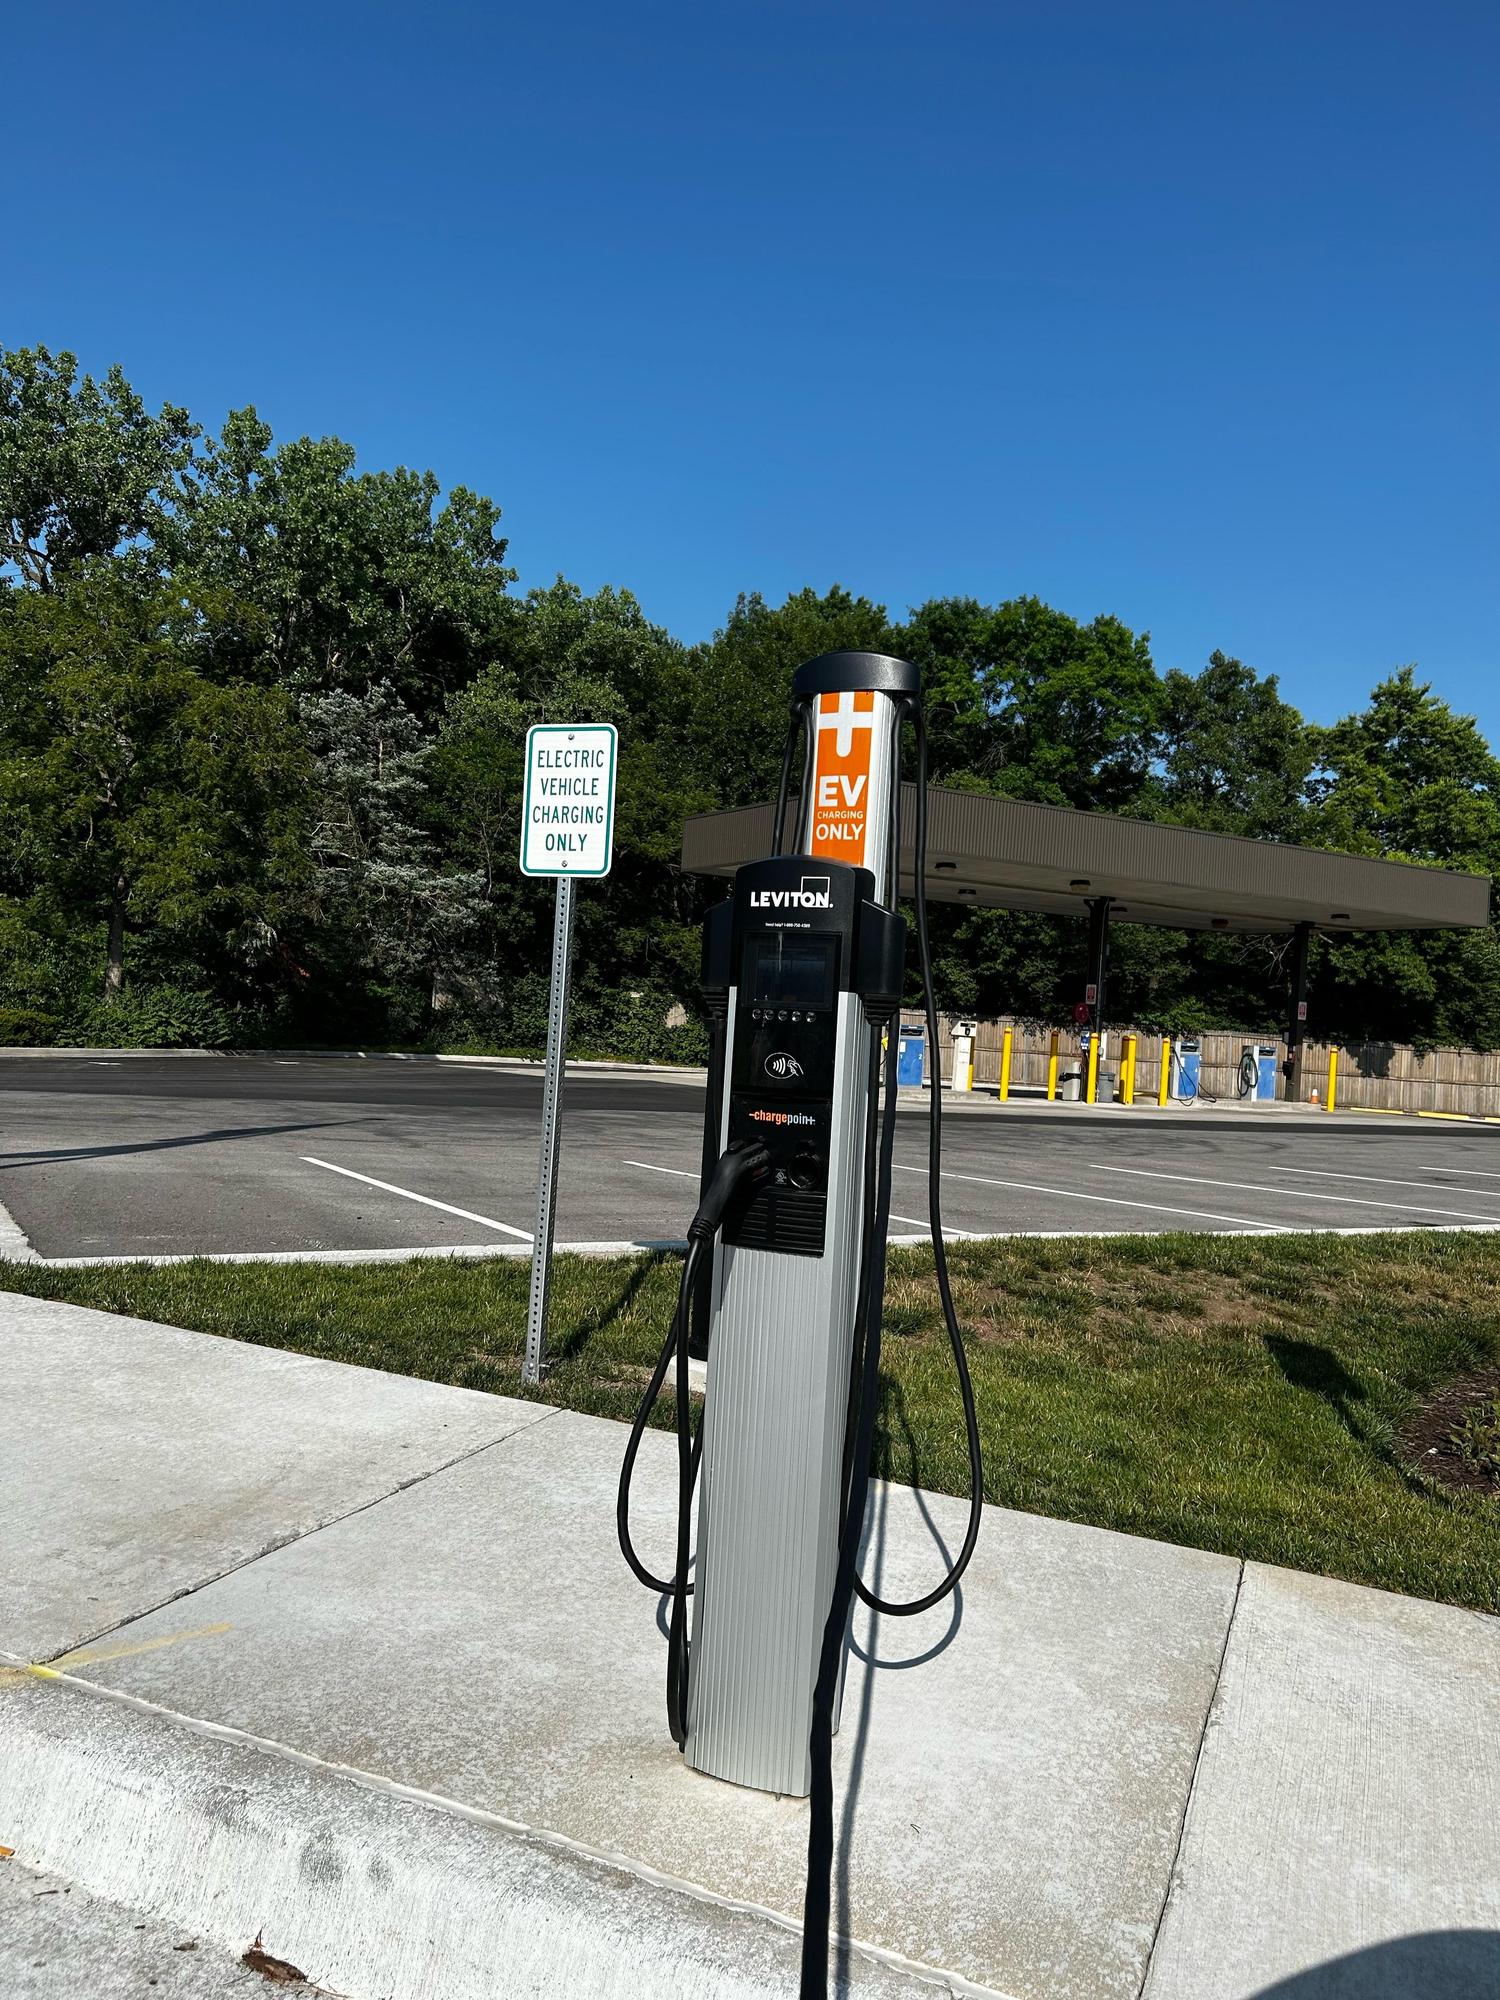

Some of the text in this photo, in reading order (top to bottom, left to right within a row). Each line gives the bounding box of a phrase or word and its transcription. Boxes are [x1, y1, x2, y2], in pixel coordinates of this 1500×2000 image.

[537, 750, 604, 768] ELECTRIC
[540, 778, 599, 796] VEHICLE
[818, 775, 867, 807] EV
[532, 805, 604, 824] CHARGING
[817, 810, 864, 819] CHARGING
[816, 823, 864, 840] ONLY
[545, 833, 588, 851] ONLY
